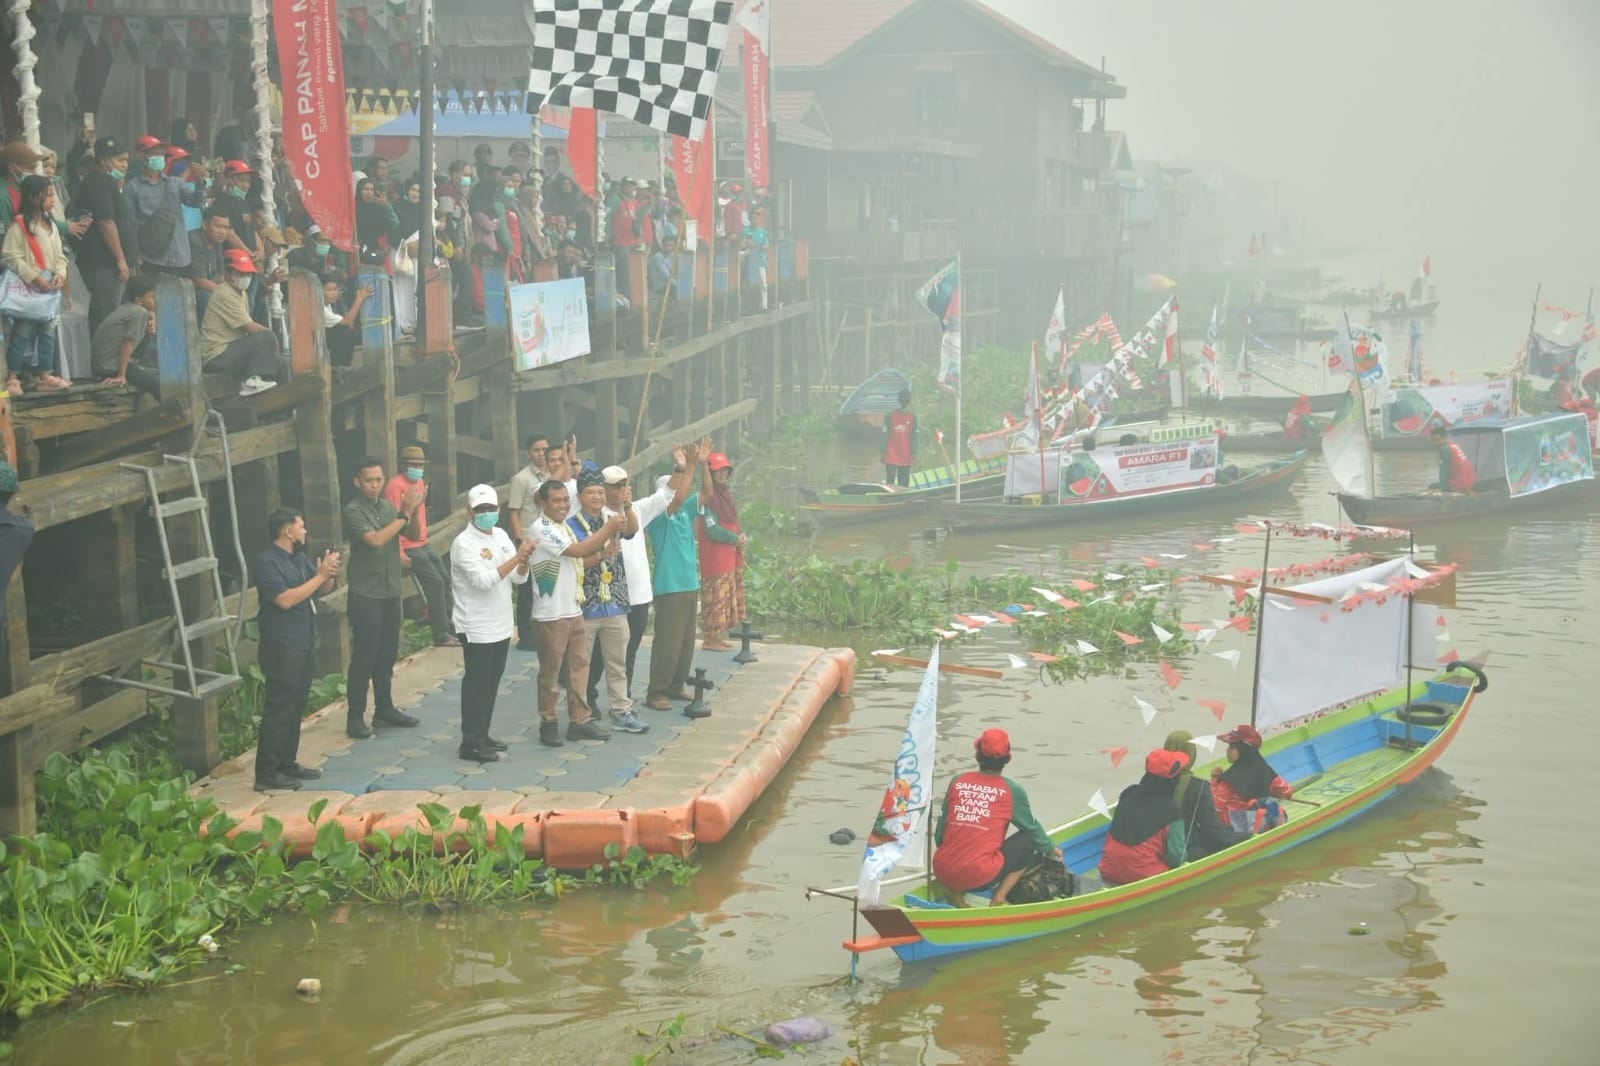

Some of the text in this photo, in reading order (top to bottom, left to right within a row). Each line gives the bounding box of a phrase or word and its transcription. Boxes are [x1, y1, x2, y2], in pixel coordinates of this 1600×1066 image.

[302, 122, 320, 179] CAP
[752, 142, 762, 170] CAP
[1127, 453, 1167, 467] AMARA
[955, 782, 1006, 797] SAHABAT
[959, 790, 997, 802] PETANI
[960, 798, 989, 809] YANG
[954, 805, 991, 817] PALING
[956, 813, 981, 823] BAIK
